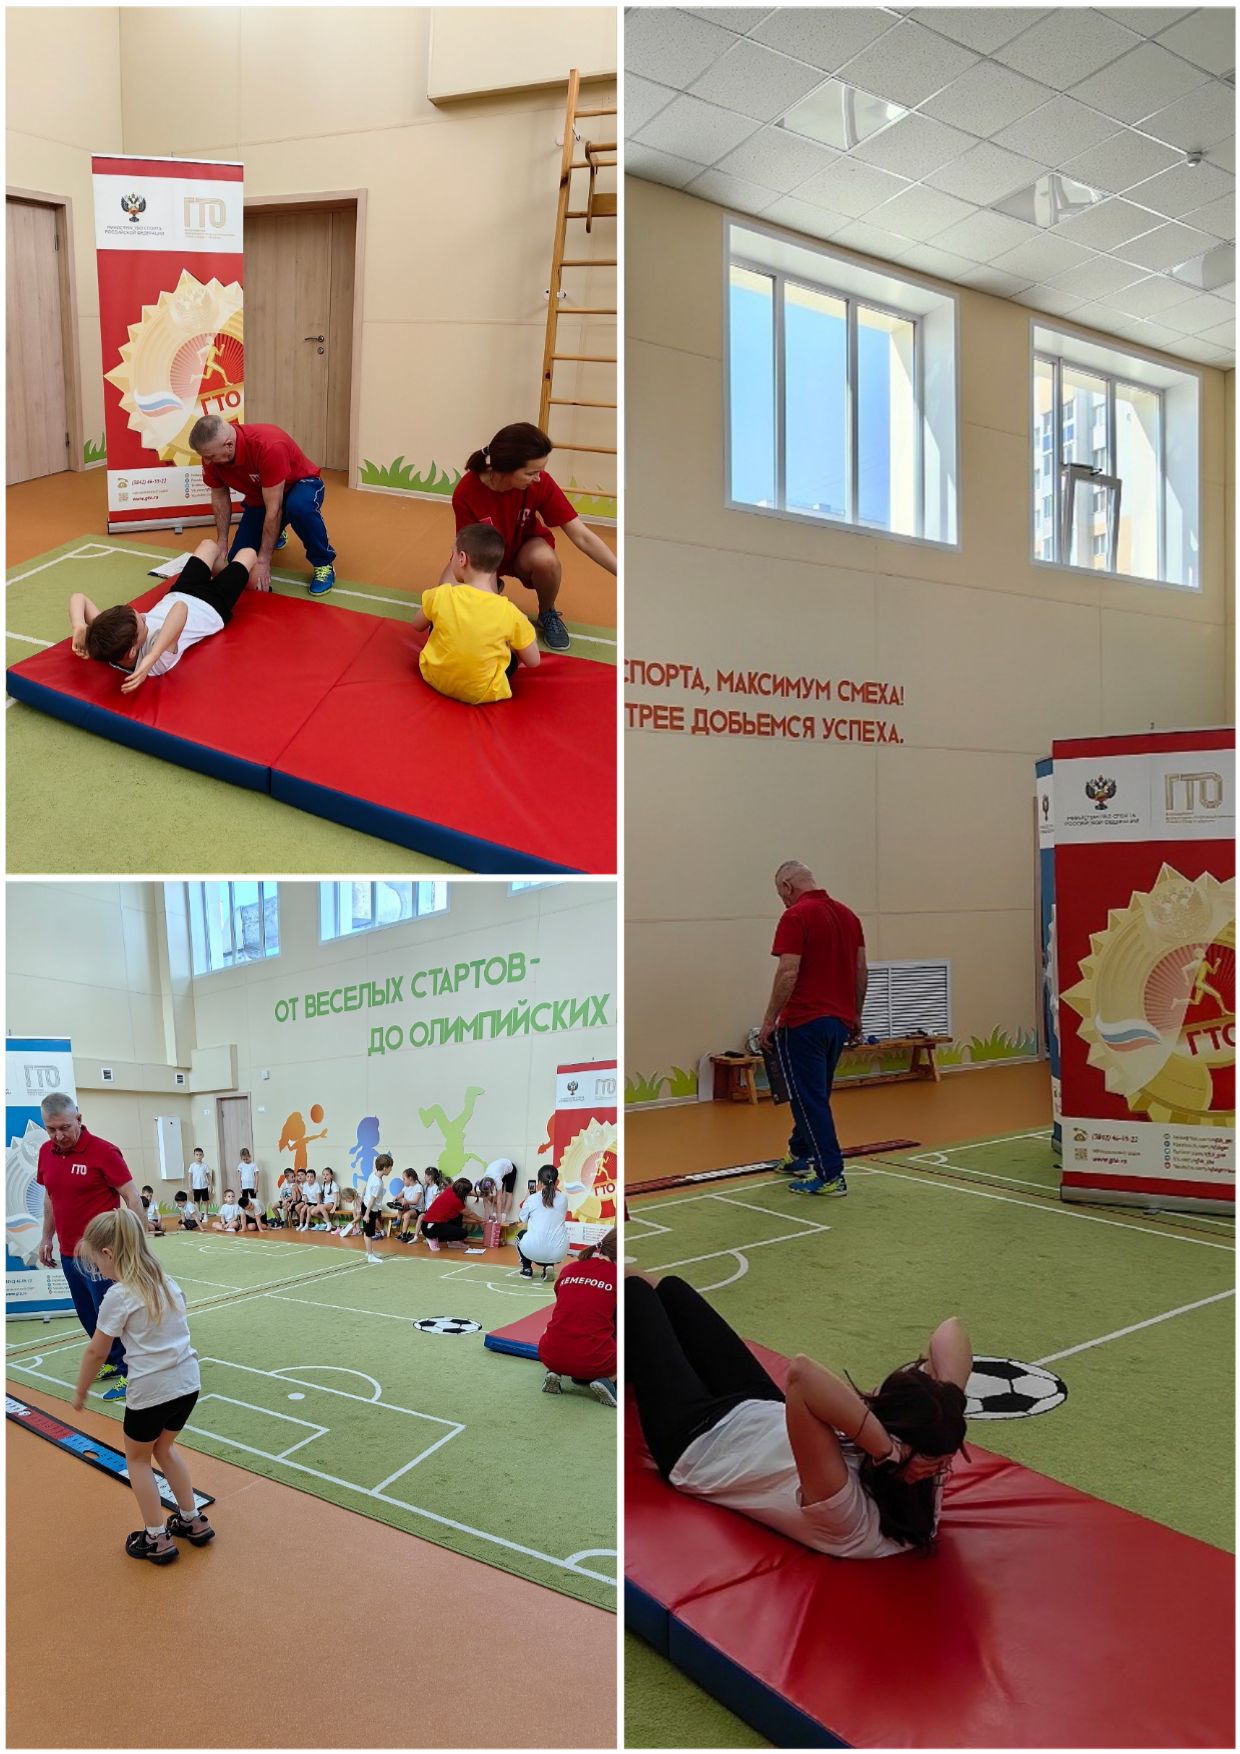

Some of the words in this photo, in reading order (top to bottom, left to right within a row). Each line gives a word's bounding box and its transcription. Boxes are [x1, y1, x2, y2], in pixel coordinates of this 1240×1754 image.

[184, 196, 226, 228] ГТО
[201, 390, 241, 416] ГТО
[717, 669, 831, 701] МАКСИМУМ
[837, 680, 905, 706] СМЕХА!
[624, 702, 685, 731] ТРЕЕ
[690, 708, 815, 739] ДОБЬЕМСЯ
[822, 718, 904, 744] УСПЕХА.
[1164, 771, 1223, 811] ГТО
[274, 997, 298, 1023] ОТ
[305, 975, 403, 1019] ВЕСЕЛЫХ
[367, 1024, 403, 1057] ДО
[409, 993, 610, 1047] ОЛИМПИЙСКИХ
[24, 1064, 61, 1088] ГТО
[595, 1078, 616, 1095] ГТО
[71, 1163, 87, 1175] ГТО
[594, 1183, 616, 1197] ГТО
